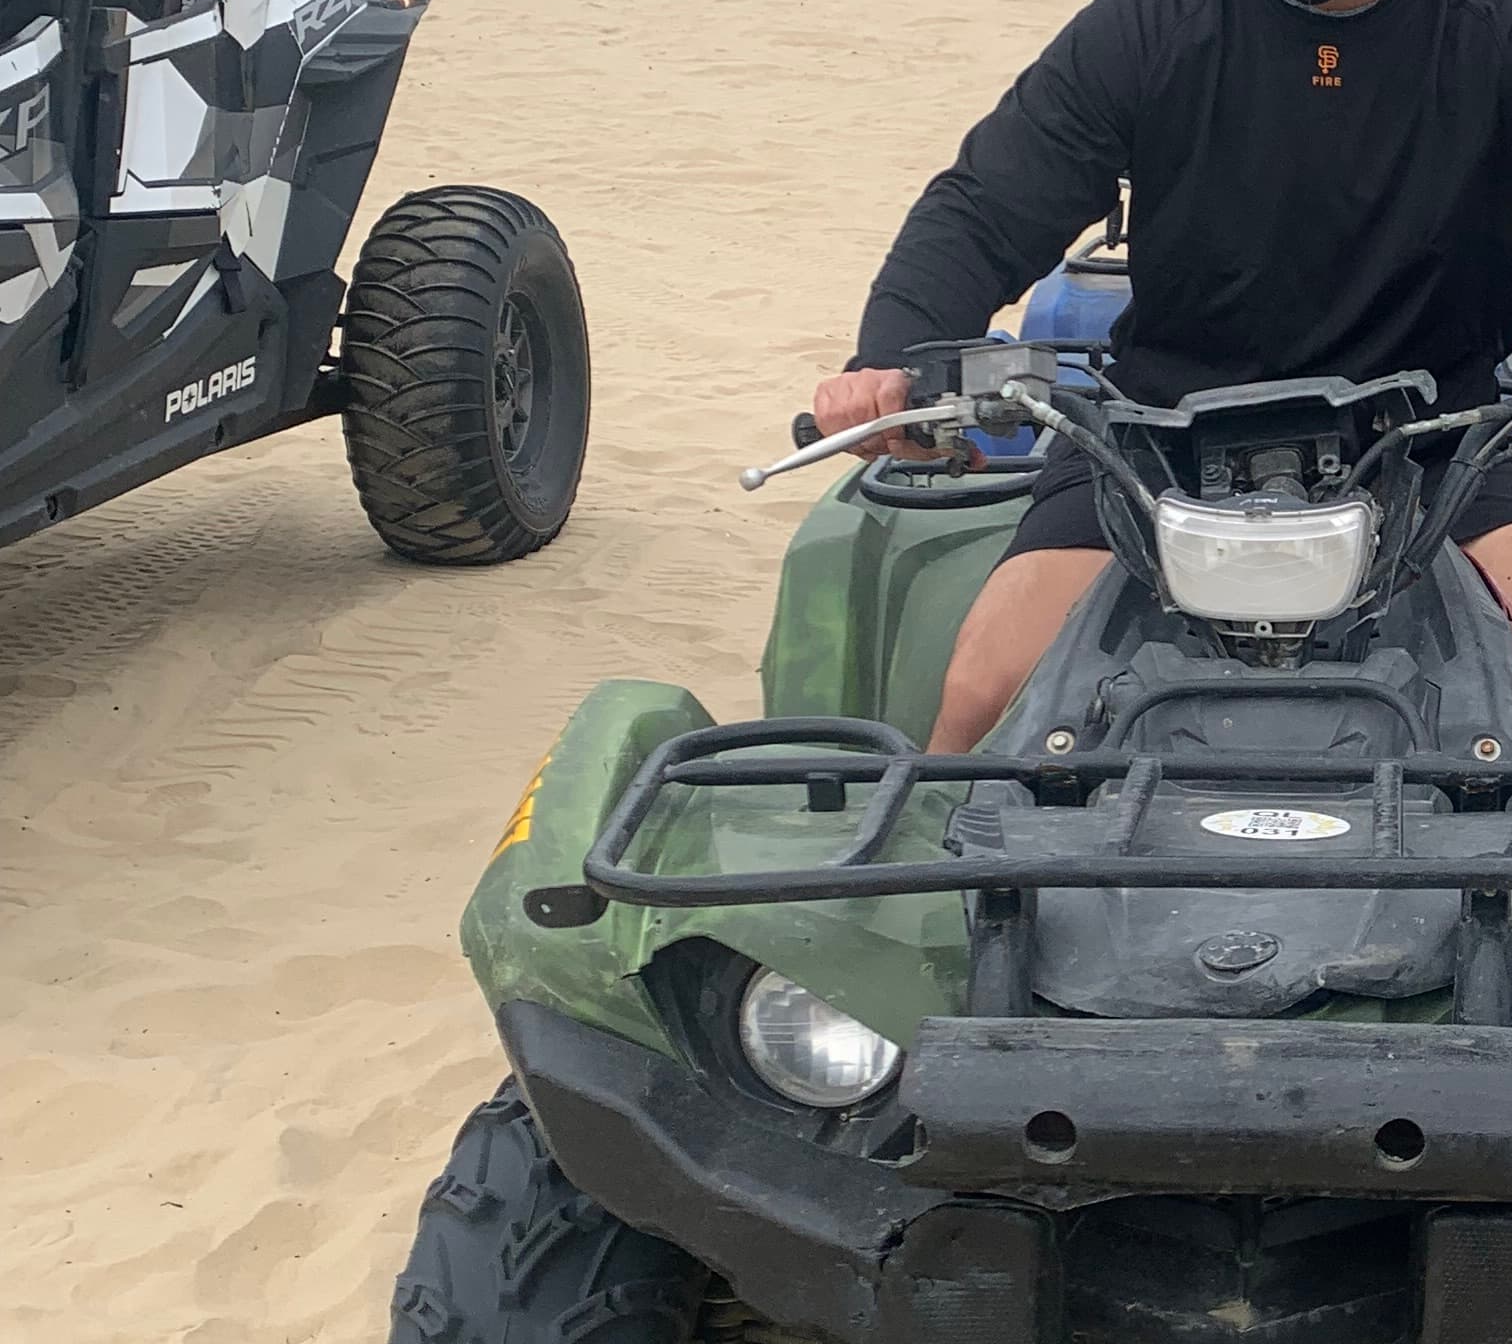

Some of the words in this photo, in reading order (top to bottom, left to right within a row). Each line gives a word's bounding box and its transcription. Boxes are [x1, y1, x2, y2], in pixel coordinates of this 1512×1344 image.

[1312, 75, 1342, 87] FIRE
[164, 355, 257, 424] POLARIS
[1240, 827, 1299, 837] 031
